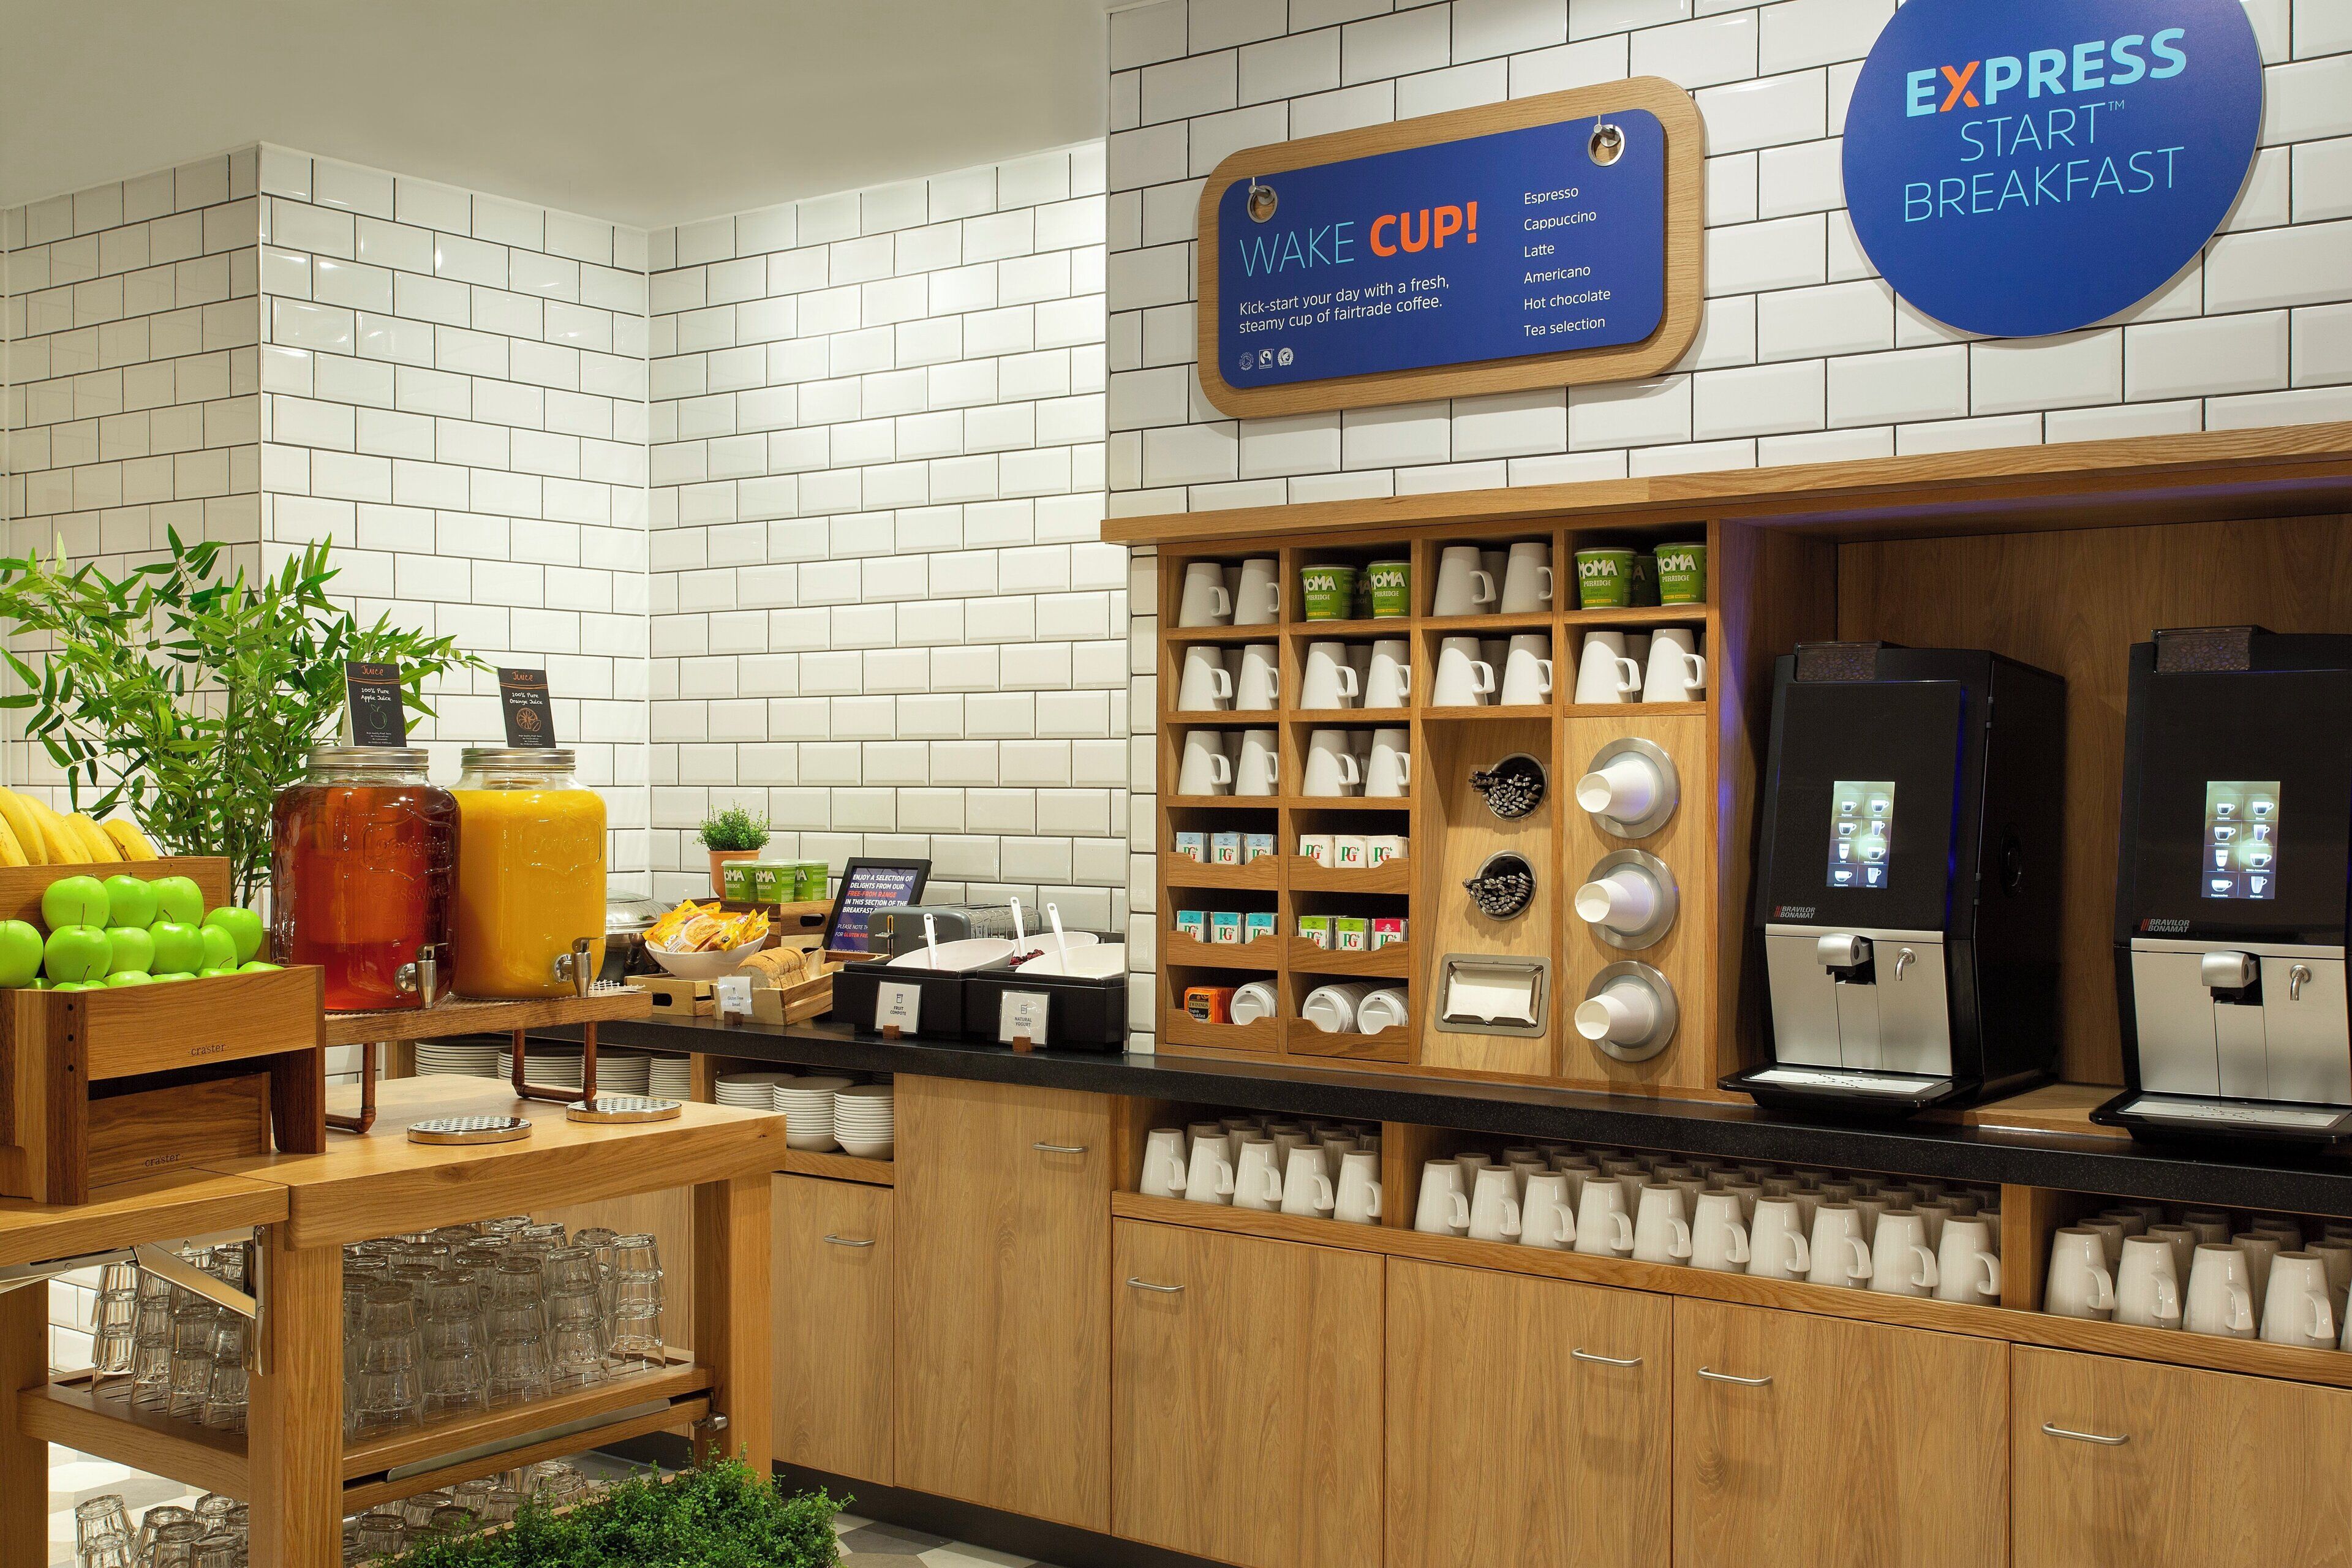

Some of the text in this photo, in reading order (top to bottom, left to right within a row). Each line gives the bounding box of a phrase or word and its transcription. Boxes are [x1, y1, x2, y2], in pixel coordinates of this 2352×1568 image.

[1907, 28, 2187, 118] EXPRESS
[1904, 146, 2184, 222] BREAKFAST
[1524, 187, 1578, 205] Espresso
[1524, 211, 1597, 231] Cappuccino
[1239, 201, 1478, 277] WAKE CUP!
[1524, 244, 1555, 257] Latte
[1523, 266, 1591, 284] Americano
[1240, 274, 1449, 315] Kick-start your day with a fresh,
[1524, 289, 1611, 310] Hot chocolate
[1239, 296, 1442, 334] steamy cup of fairtrade coffee.
[1523, 317, 1605, 336] Tea selection
[361, 665, 383, 676] Juice
[512, 671, 533, 681] Juice
[1218, 848, 1232, 861] PG
[1306, 845, 1321, 859] PG
[1341, 846, 1357, 862] PG
[1374, 846, 1390, 862] PG
[725, 869, 745, 881] OMA
[756, 870, 777, 883] OMA
[1219, 927, 1232, 940] PG
[1343, 933, 1357, 947] PG
